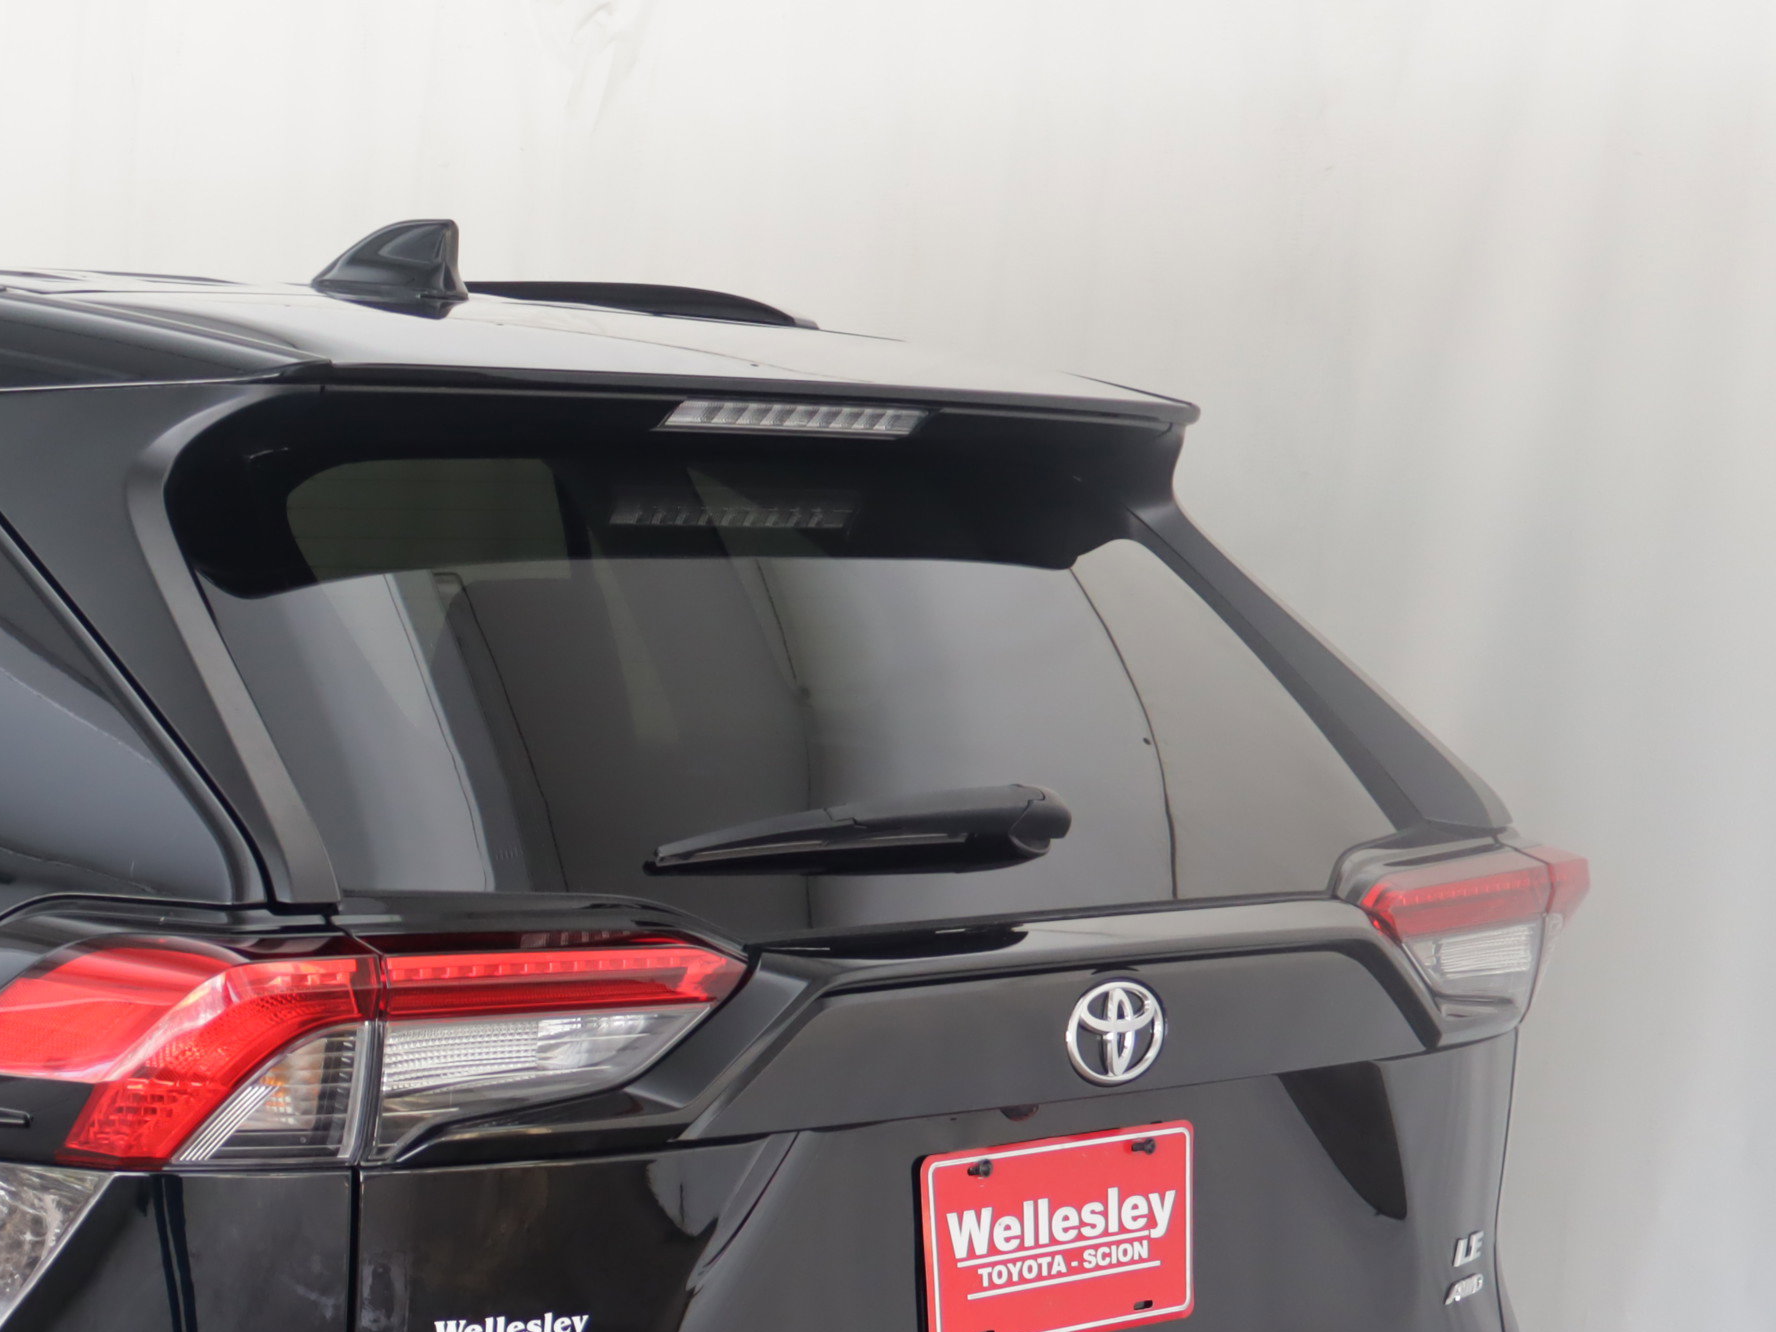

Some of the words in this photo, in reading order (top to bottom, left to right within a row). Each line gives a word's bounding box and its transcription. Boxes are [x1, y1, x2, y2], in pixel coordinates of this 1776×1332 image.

[946, 1187, 1176, 1258] Wellesley
[977, 1254, 1067, 1286] TOYOTA
[1082, 1239, 1150, 1269] SCION
[1451, 1230, 1484, 1267] LE
